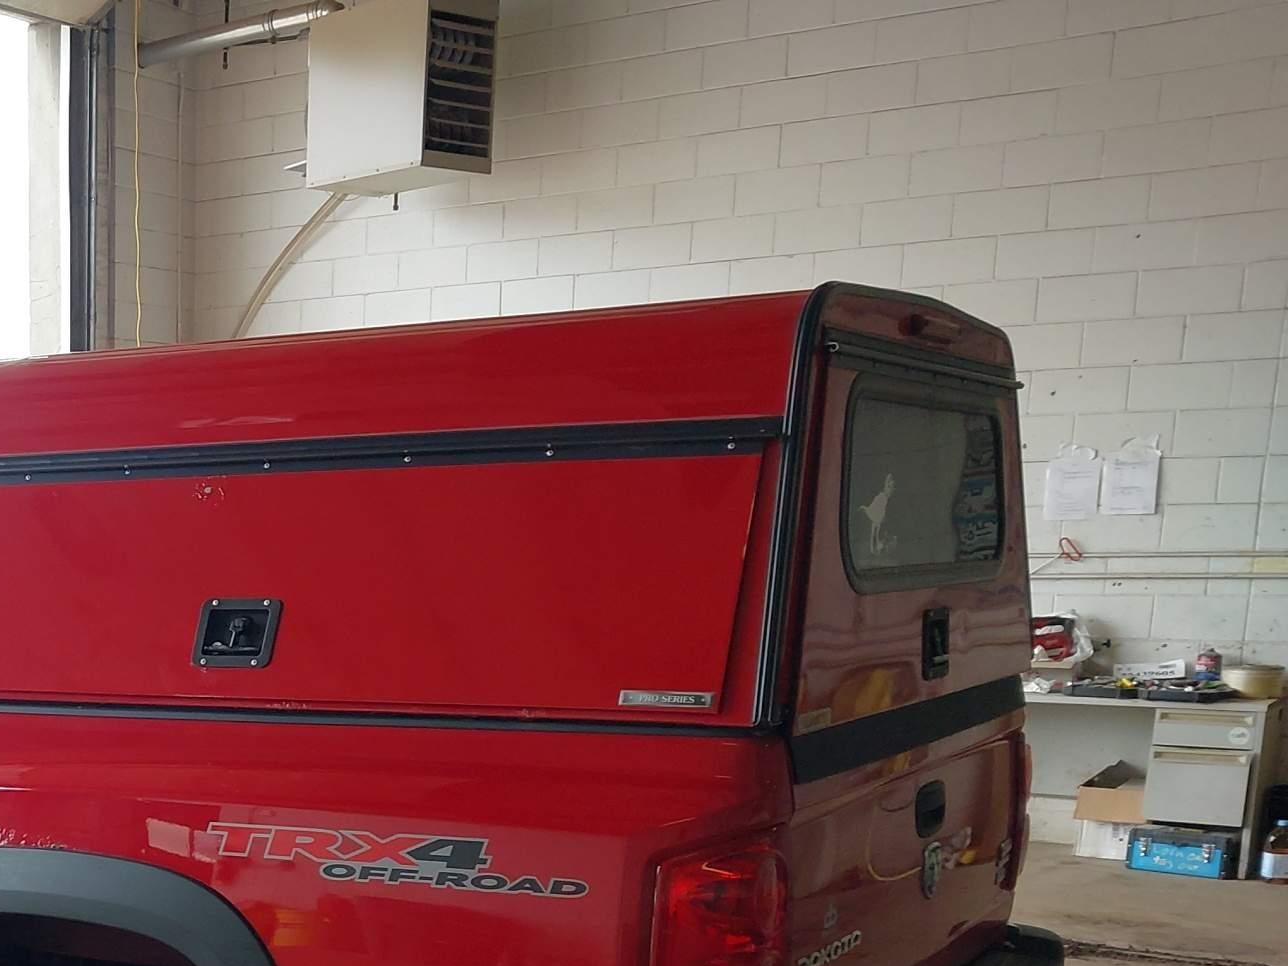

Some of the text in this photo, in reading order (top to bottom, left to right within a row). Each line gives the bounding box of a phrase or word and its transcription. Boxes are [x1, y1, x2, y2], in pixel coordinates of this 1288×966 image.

[639, 695, 696, 704] PRO SERIES
[207, 822, 493, 873] TRX4
[320, 862, 590, 899] OFF-ROAD
